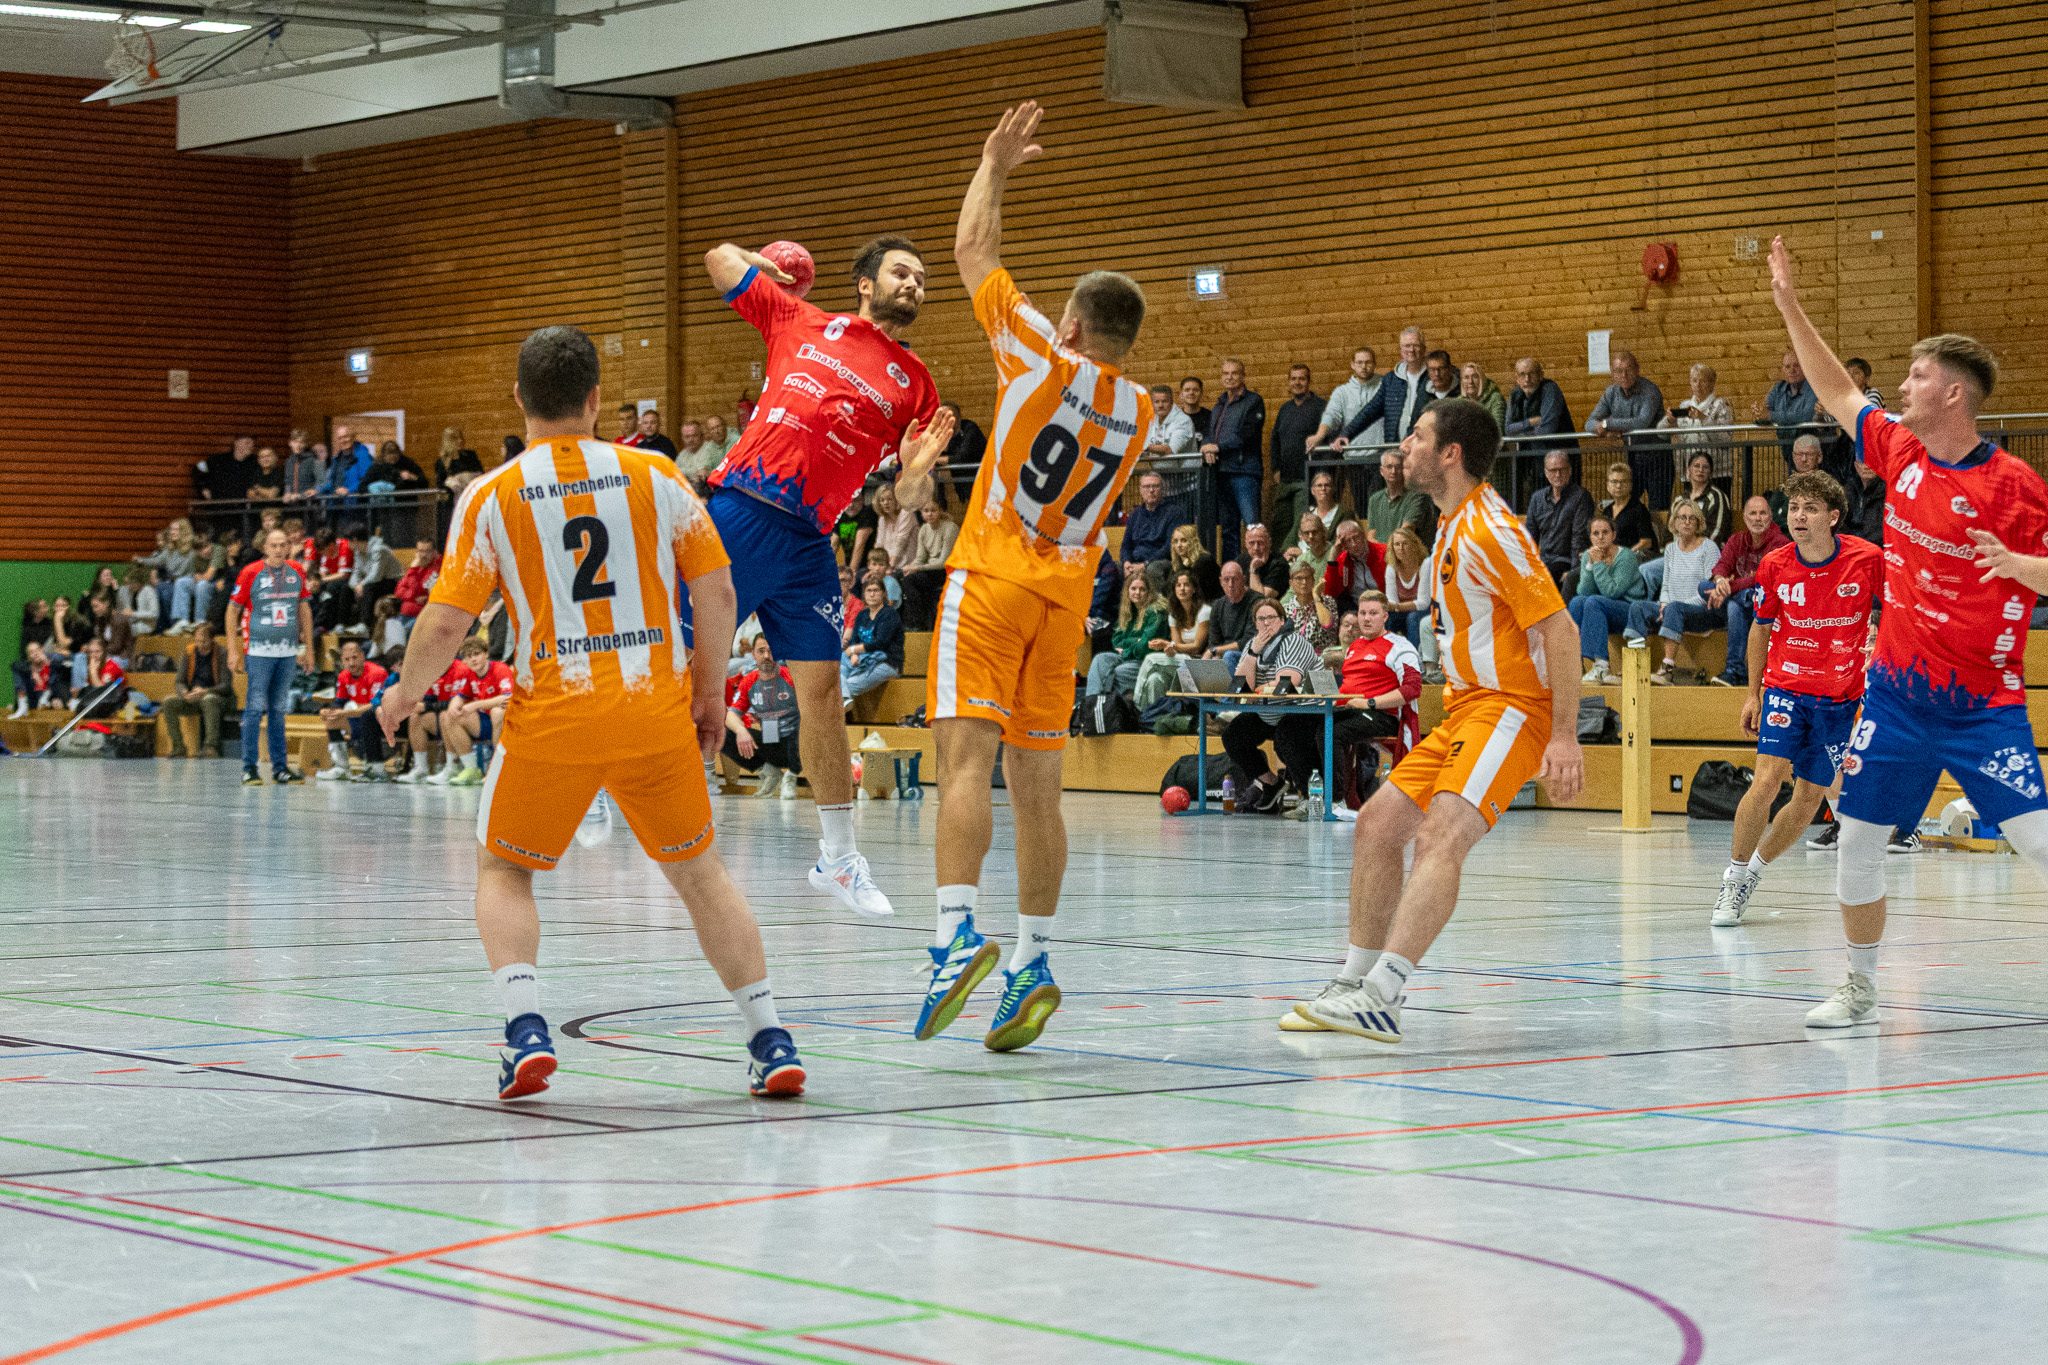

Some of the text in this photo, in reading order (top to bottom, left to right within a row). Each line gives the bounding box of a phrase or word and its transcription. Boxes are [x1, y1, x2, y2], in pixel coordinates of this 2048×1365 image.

[823, 316, 851, 341] 6
[783, 377, 825, 399] bautec
[1079, 402, 1138, 436] Kirchhellen
[1019, 423, 1124, 521] 97
[518, 474, 631, 503] TSG Kirchhellen
[562, 515, 617, 604] 2
[1777, 582, 1806, 606] 44
